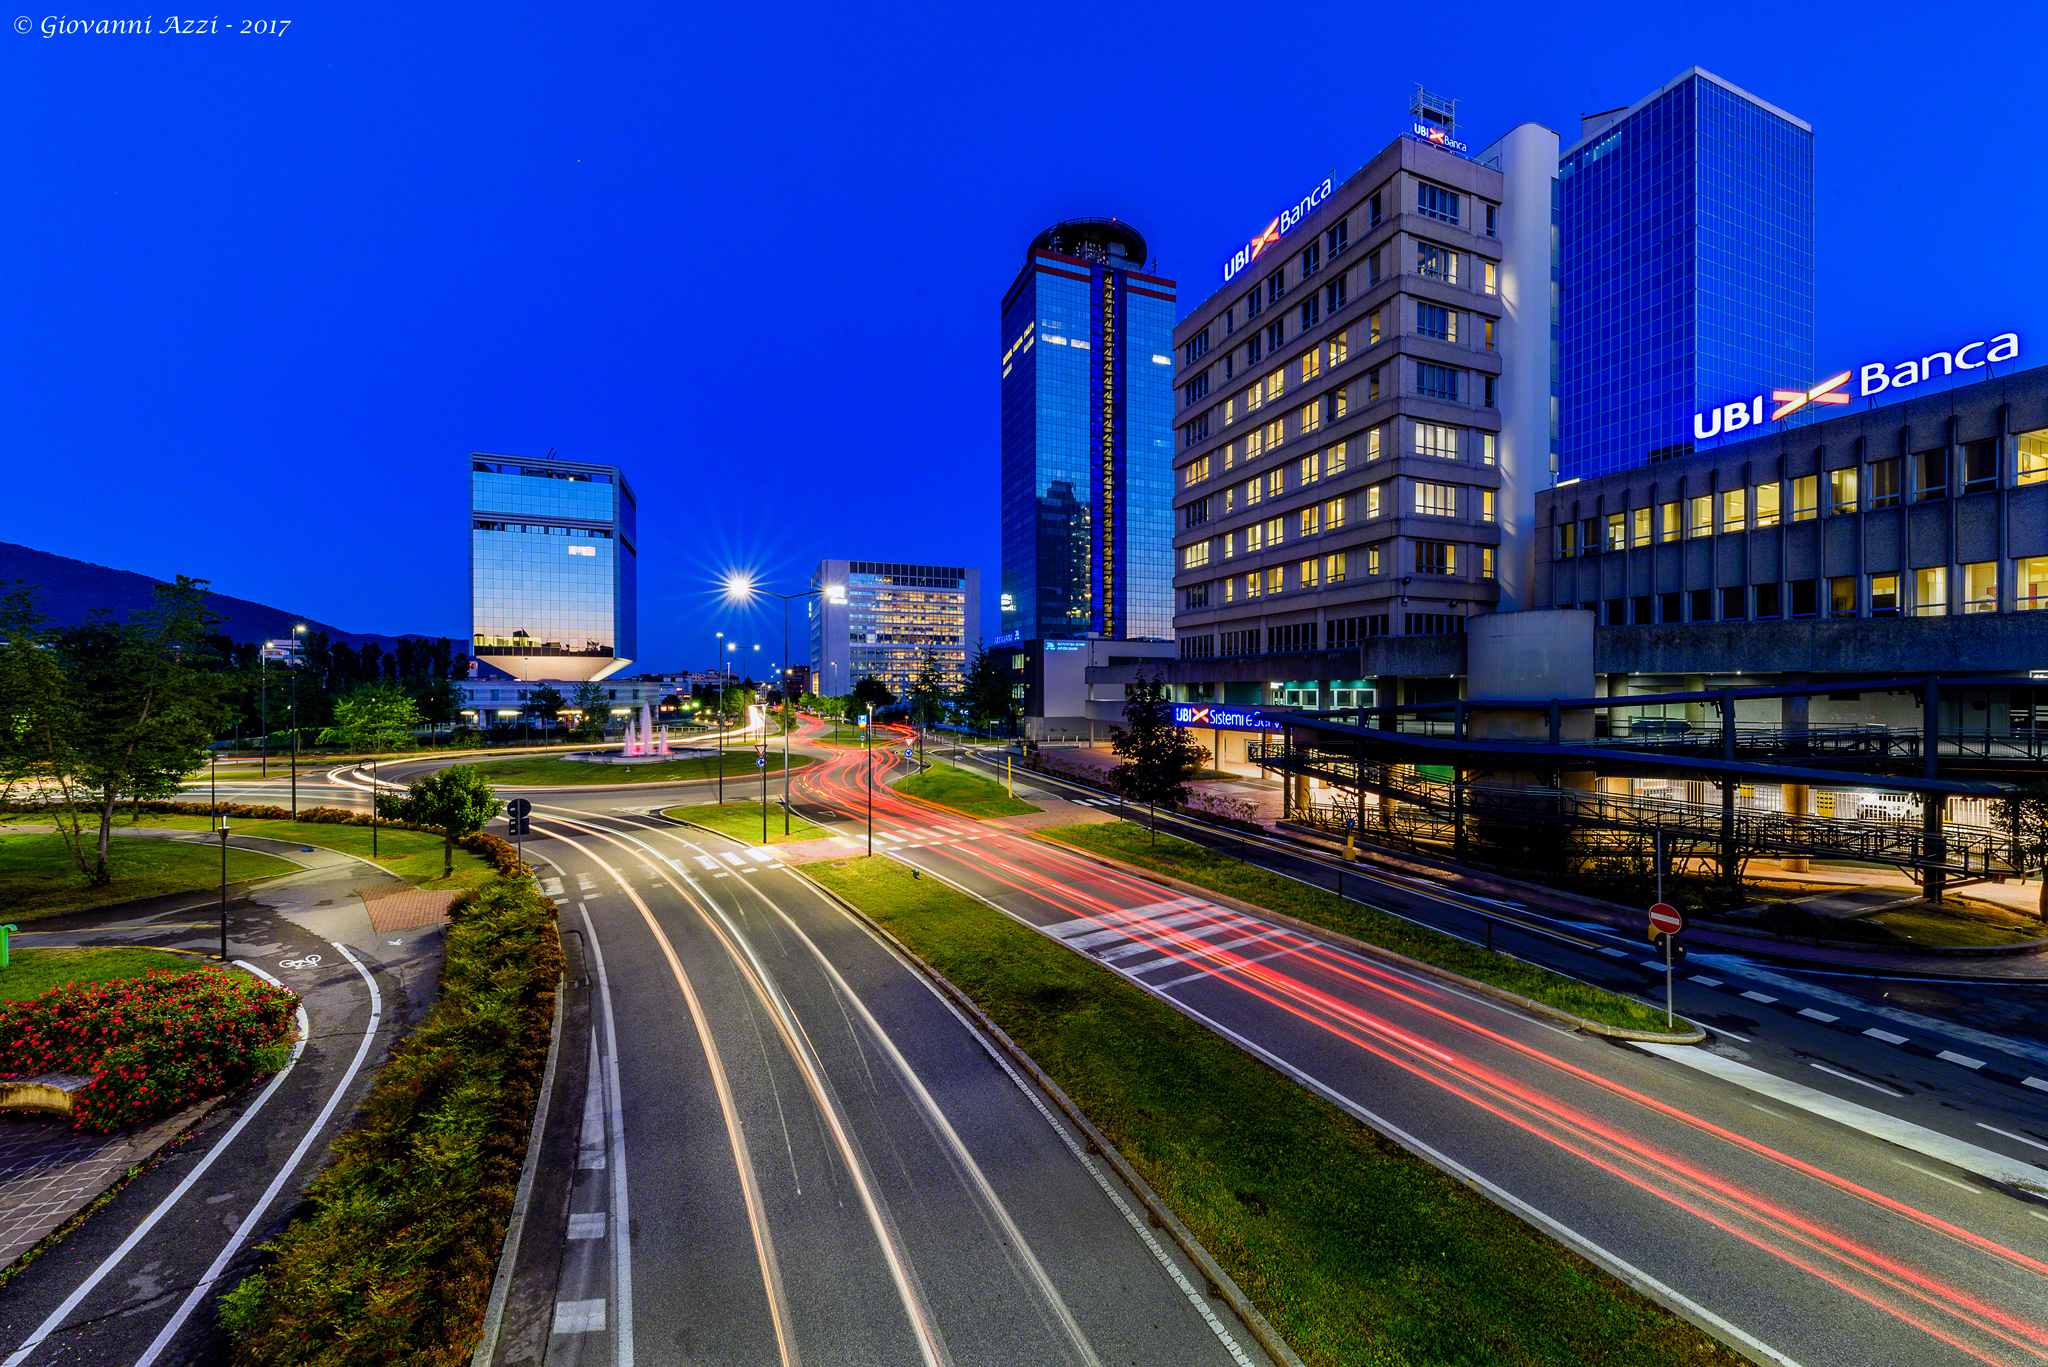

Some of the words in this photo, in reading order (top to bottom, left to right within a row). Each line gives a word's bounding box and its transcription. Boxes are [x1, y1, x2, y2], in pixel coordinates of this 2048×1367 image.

[1414, 123, 1429, 138] UBI
[1444, 135, 1467, 152] Banca
[1224, 244, 1249, 282] UBI
[1280, 178, 1331, 234] Banca
[1694, 395, 1763, 439] UBI
[1861, 332, 2018, 397] Banca
[1176, 707, 1192, 722] UBI
[1209, 709, 1244, 726] Sistemi
[1245, 714, 1253, 727] e
